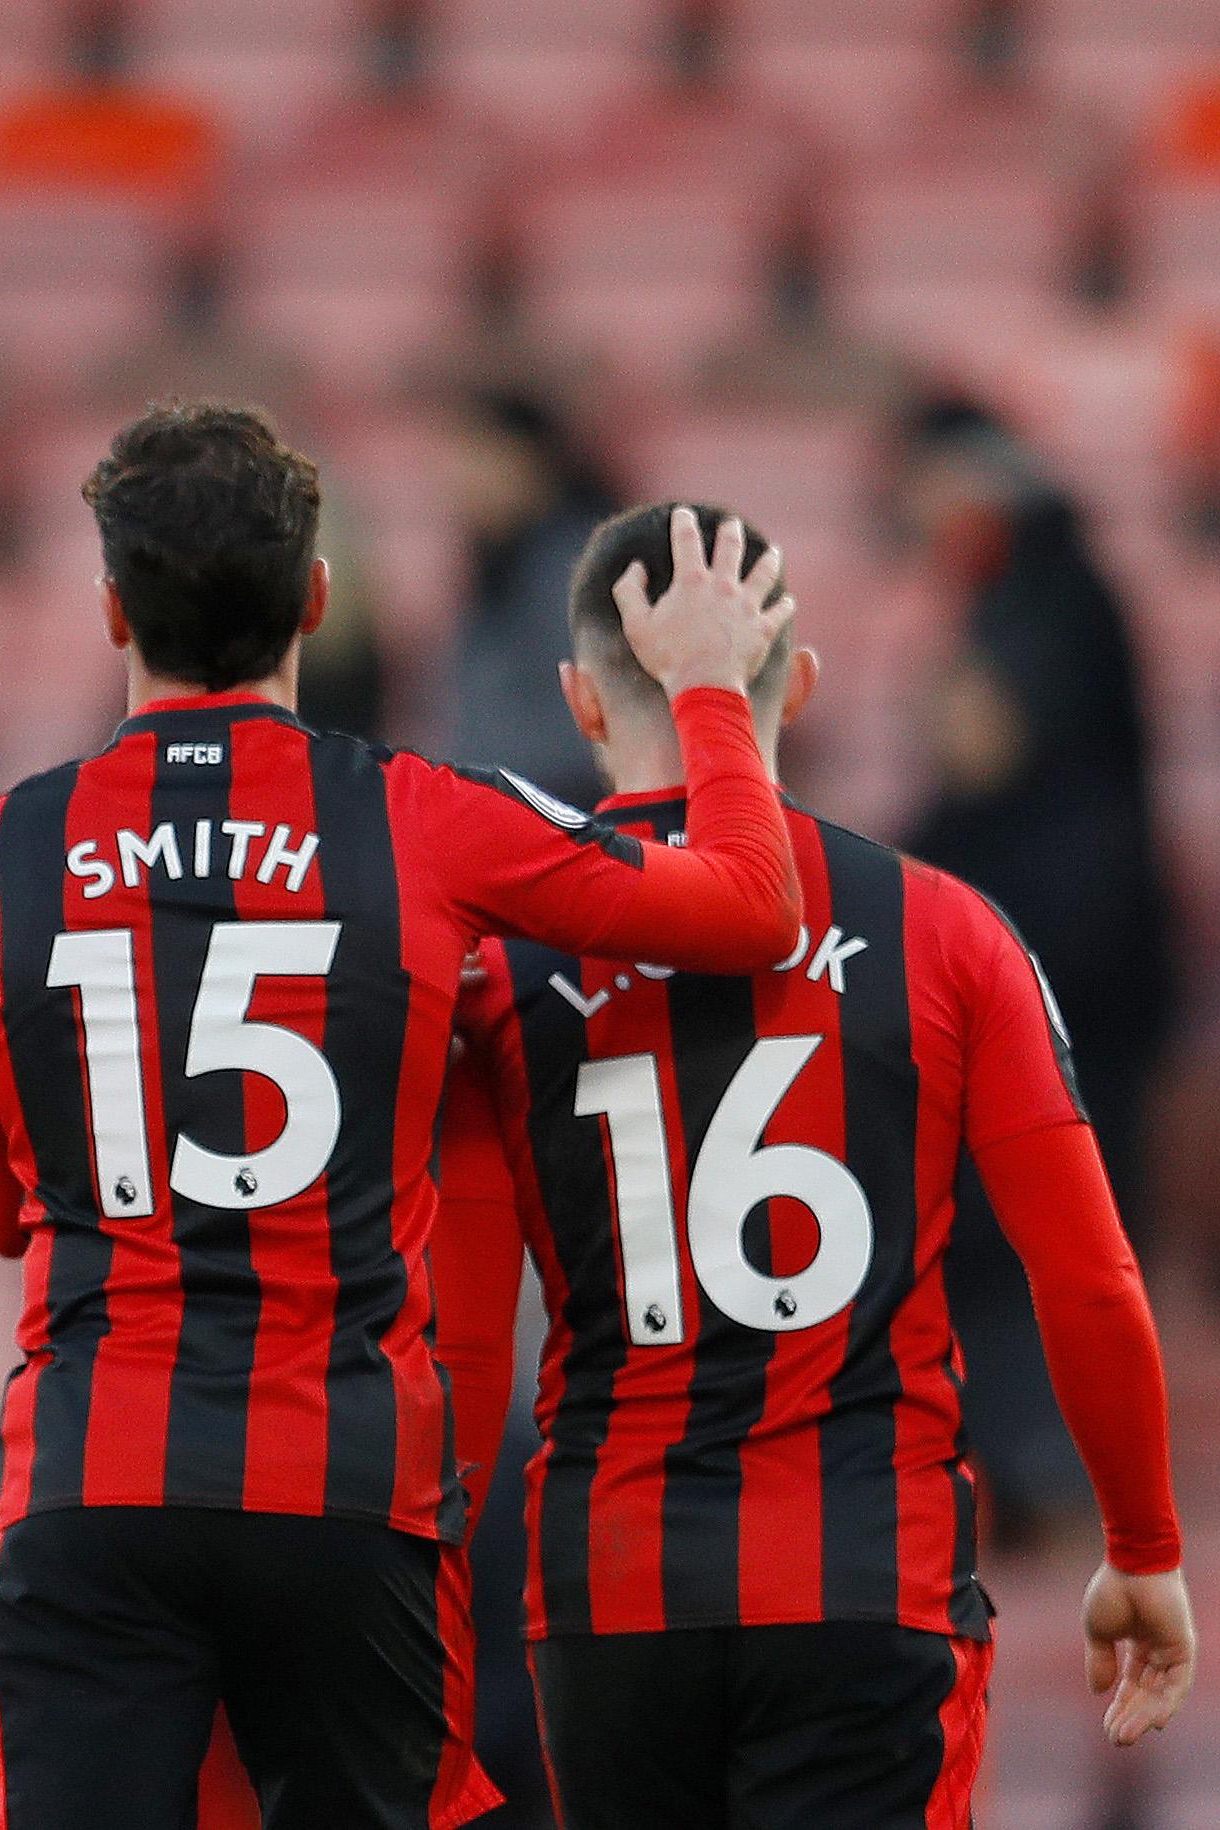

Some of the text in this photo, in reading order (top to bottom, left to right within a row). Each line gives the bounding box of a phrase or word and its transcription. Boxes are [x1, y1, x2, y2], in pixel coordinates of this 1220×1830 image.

[166, 743, 223, 764] AFCB
[67, 819, 321, 898] SMITH
[45, 920, 343, 1218] 15
[574, 1034, 873, 1345] 16
